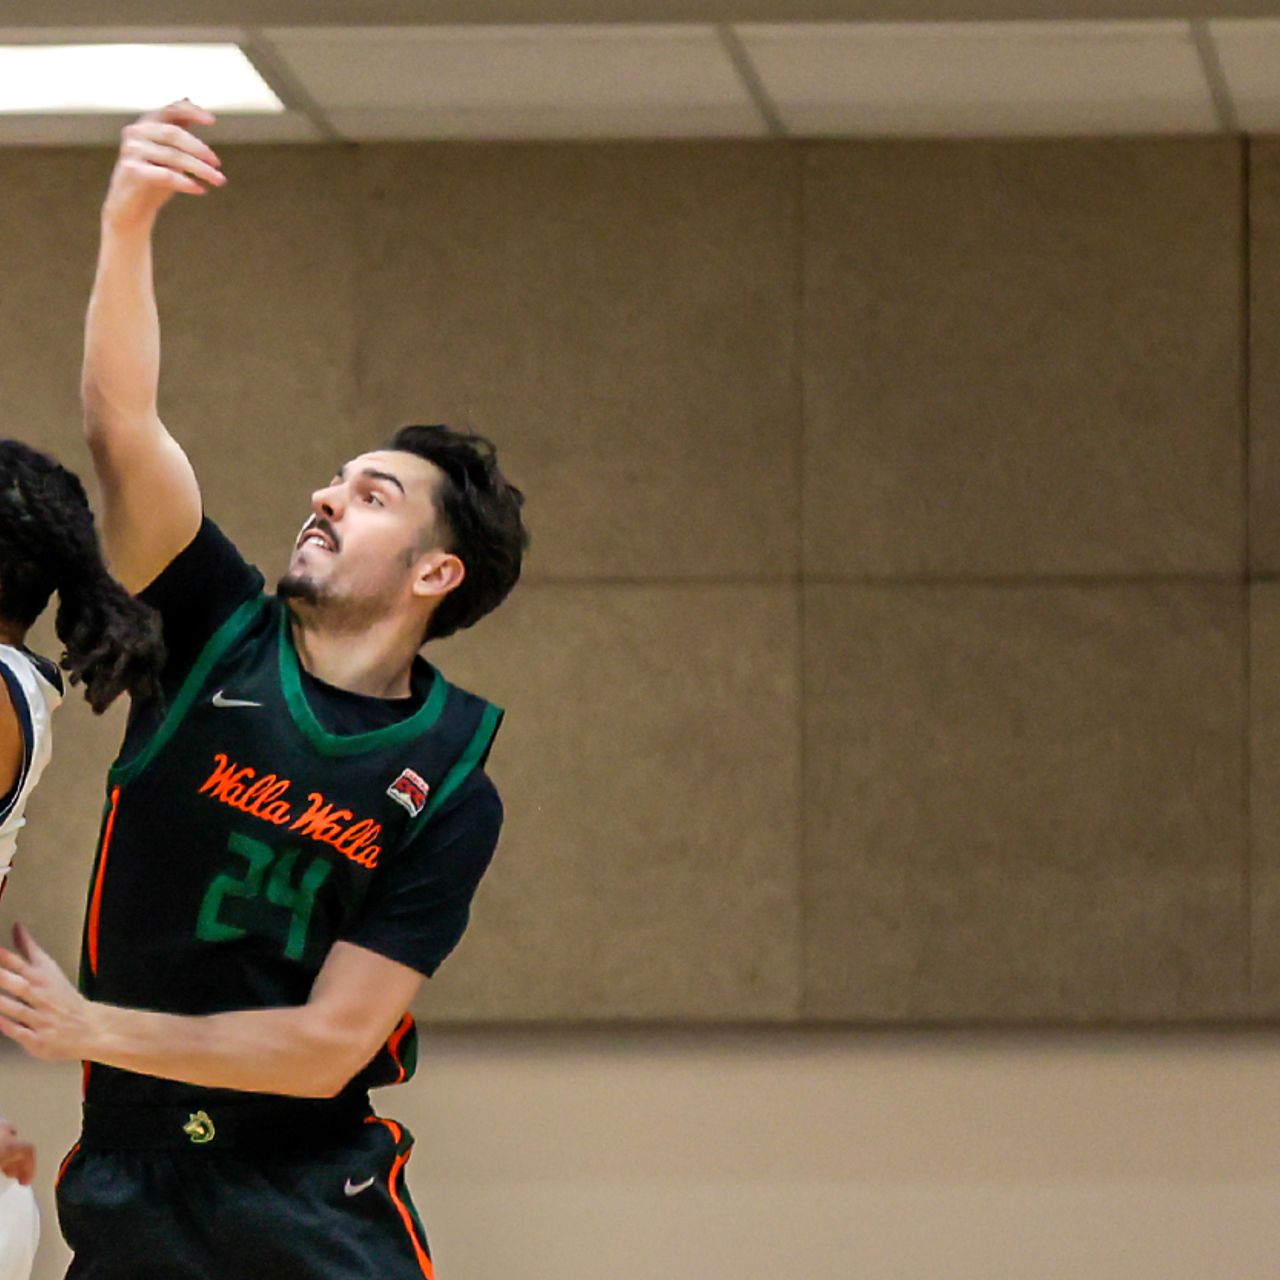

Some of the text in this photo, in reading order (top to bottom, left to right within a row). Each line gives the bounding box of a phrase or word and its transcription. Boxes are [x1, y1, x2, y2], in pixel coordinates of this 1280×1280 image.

[198, 753, 383, 869] Walla Walla
[195, 832, 332, 960] 24
